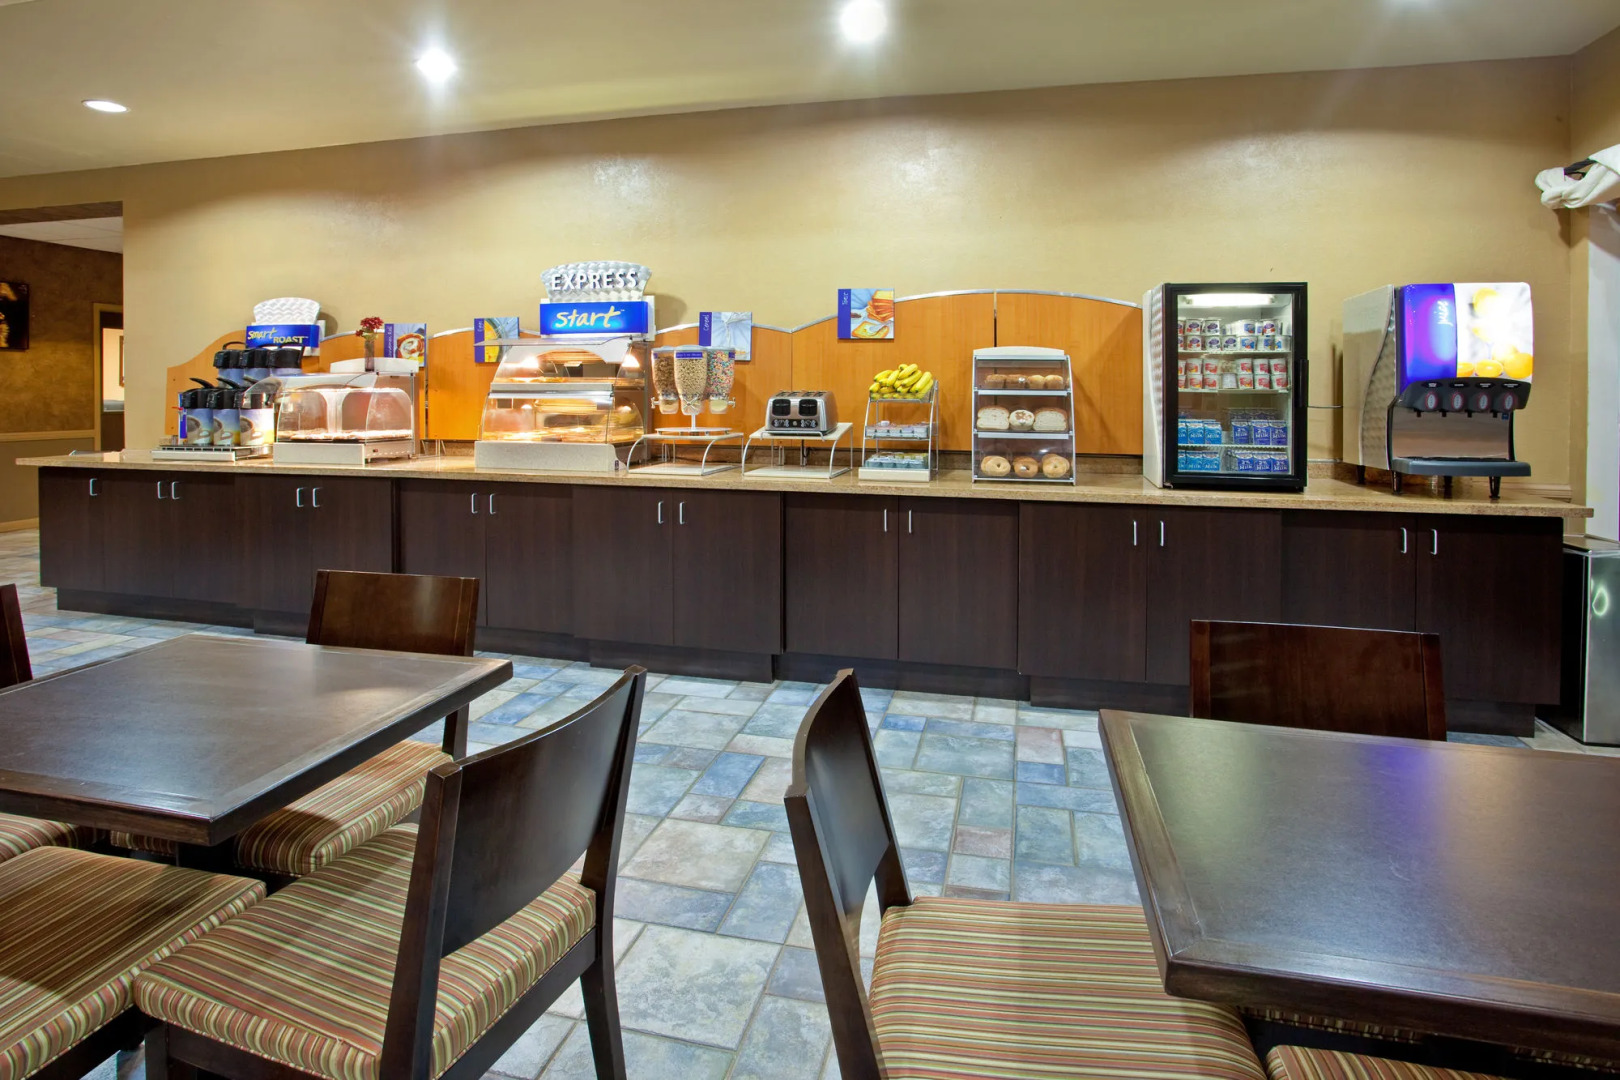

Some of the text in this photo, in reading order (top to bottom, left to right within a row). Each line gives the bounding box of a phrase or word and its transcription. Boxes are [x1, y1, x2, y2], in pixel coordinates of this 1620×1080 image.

[551, 270, 638, 291] EXPRESS
[555, 305, 621, 328] Start
[1433, 300, 1454, 327] juice
[247, 326, 278, 340] Smart
[273, 335, 304, 344] ROAST
